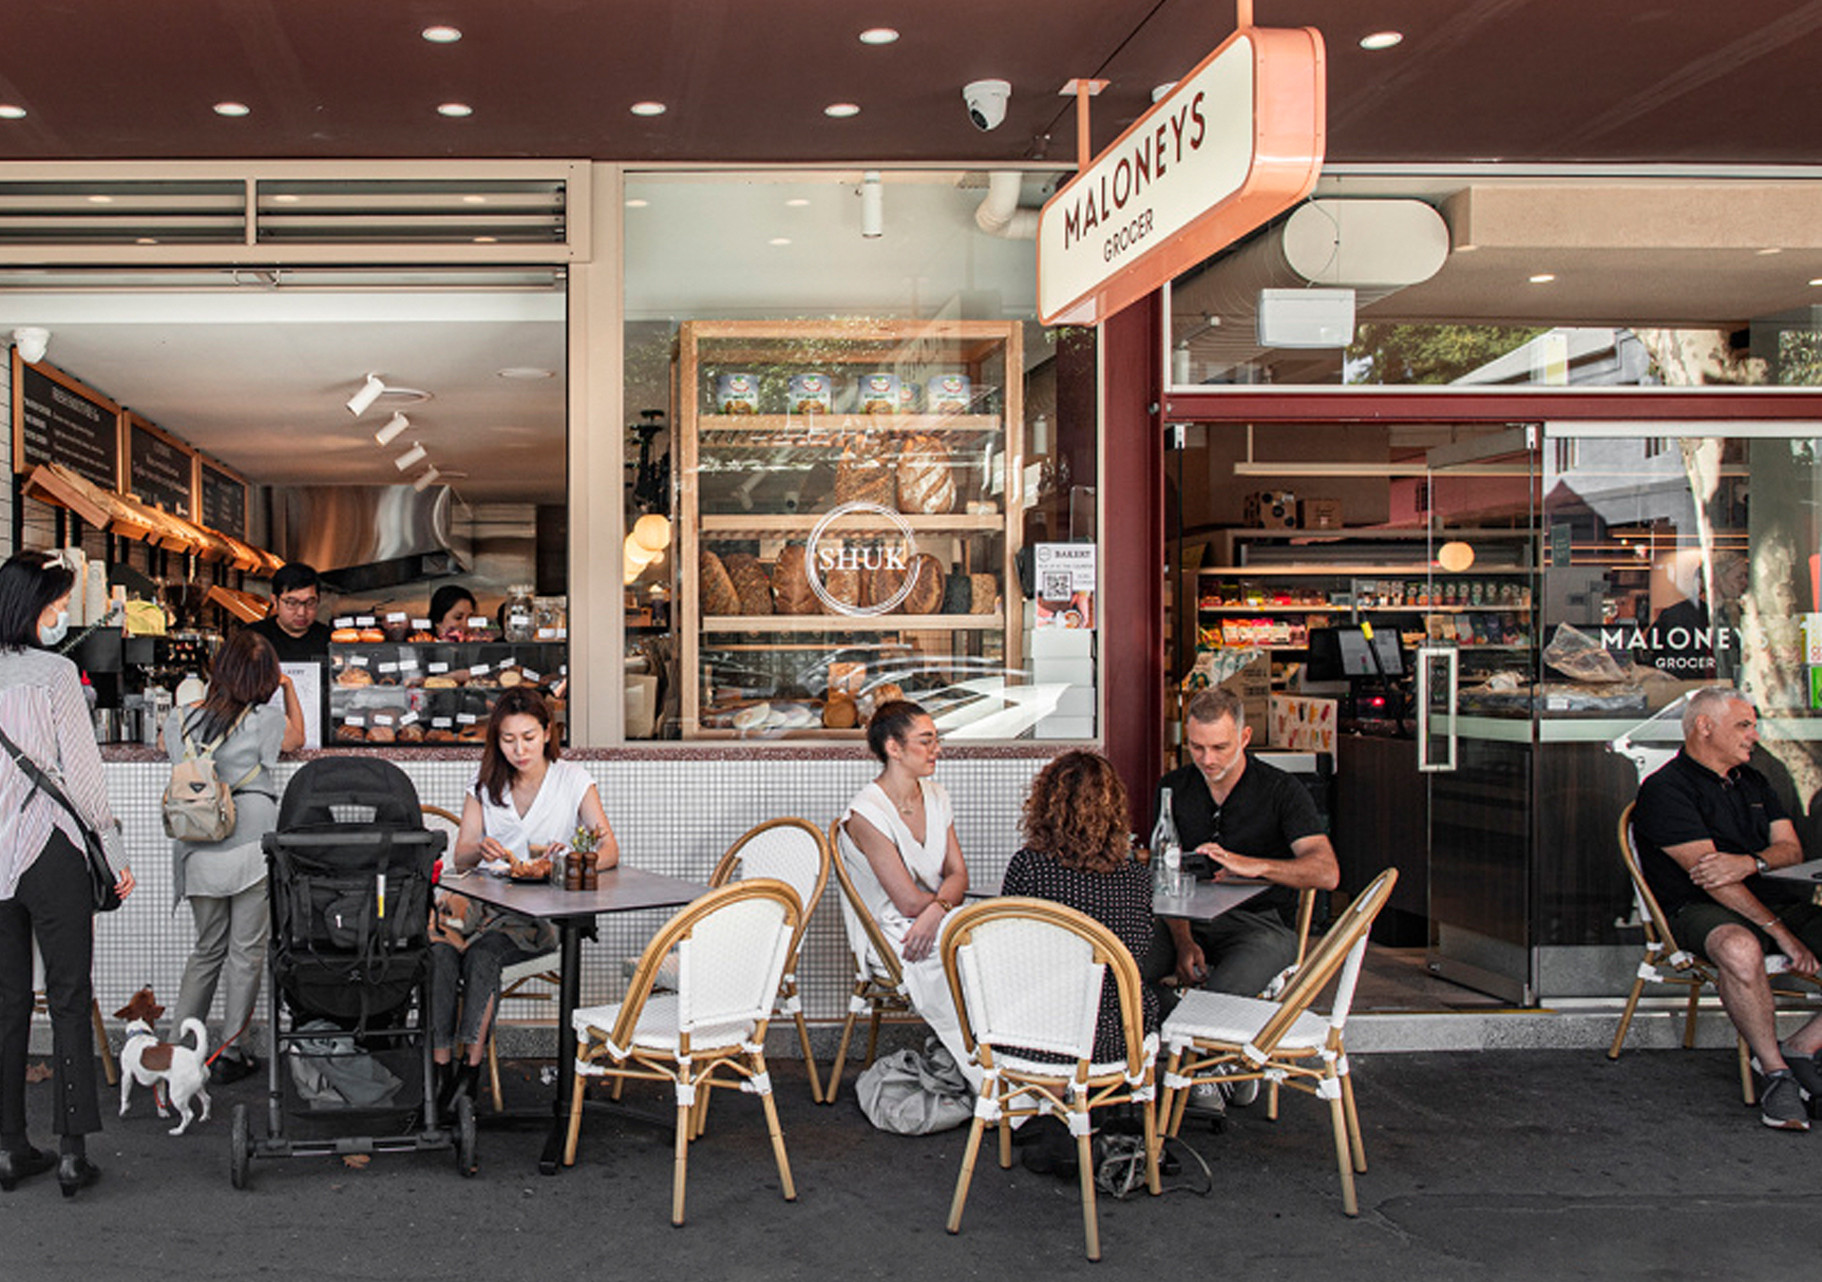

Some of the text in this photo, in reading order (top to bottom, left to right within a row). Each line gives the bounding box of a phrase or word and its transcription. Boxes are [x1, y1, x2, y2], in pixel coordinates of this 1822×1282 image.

[1065, 91, 1206, 250] MALONEYS
[1103, 208, 1154, 262] GROCER
[819, 547, 906, 571] SHUK
[1055, 551, 1091, 559] BAKERY
[1655, 657, 1717, 669] GROCER
